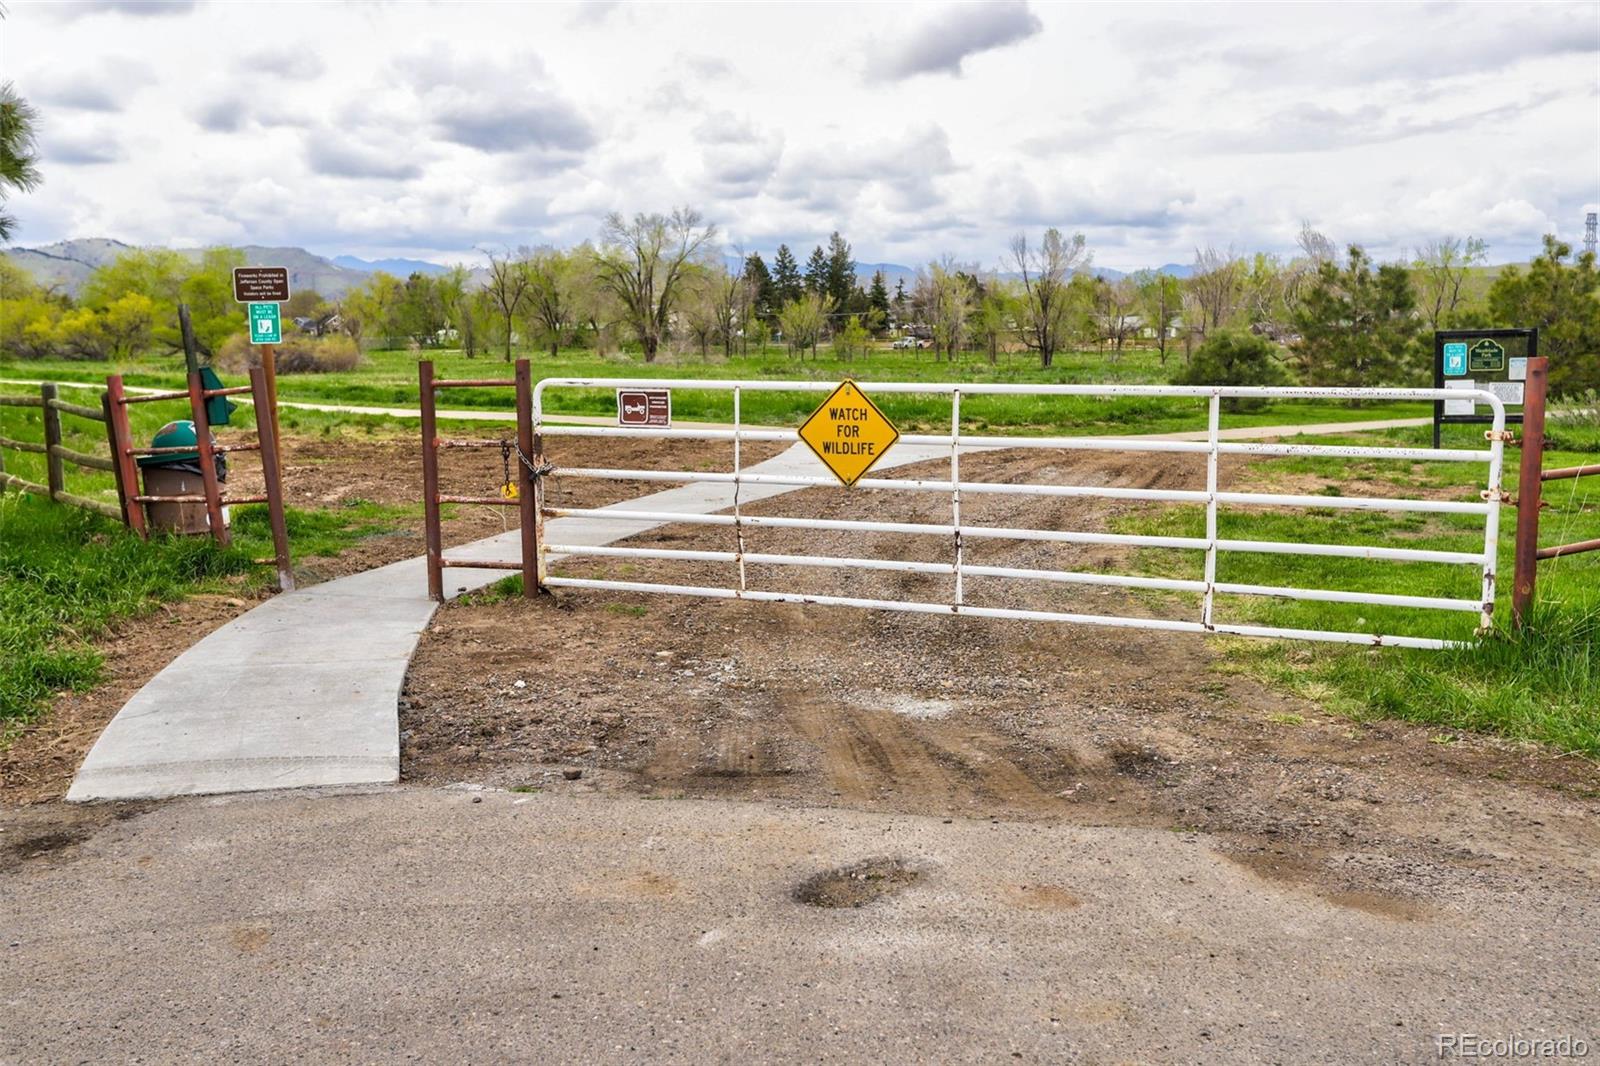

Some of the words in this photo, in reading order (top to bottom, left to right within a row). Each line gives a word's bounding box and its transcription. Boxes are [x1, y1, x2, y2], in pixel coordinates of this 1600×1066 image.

[830, 408, 867, 420] WATCH
[837, 425, 860, 437] FOR
[822, 442, 875, 455] WILDLIFE
